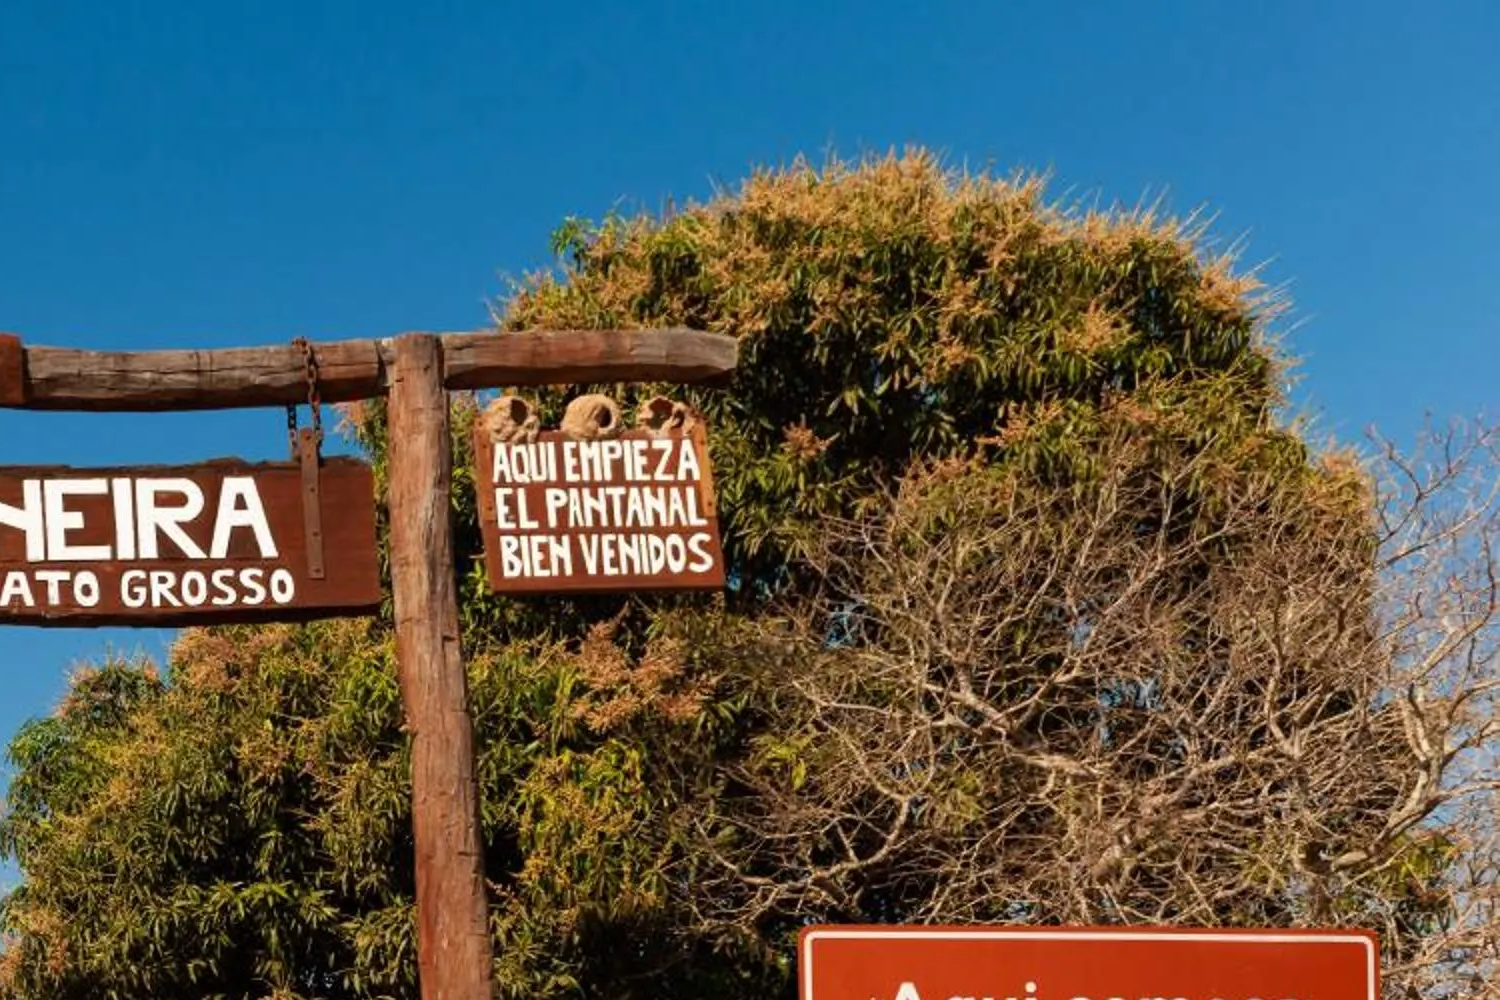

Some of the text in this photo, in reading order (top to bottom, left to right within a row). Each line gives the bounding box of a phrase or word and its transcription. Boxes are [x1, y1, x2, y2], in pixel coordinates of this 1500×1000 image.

[492, 439, 701, 484] AQUI EMPIEZA
[494, 485, 709, 531] EL PANTANAL
[499, 532, 714, 579] BIEN VENIDOS
[120, 567, 295, 608] GROSSO
